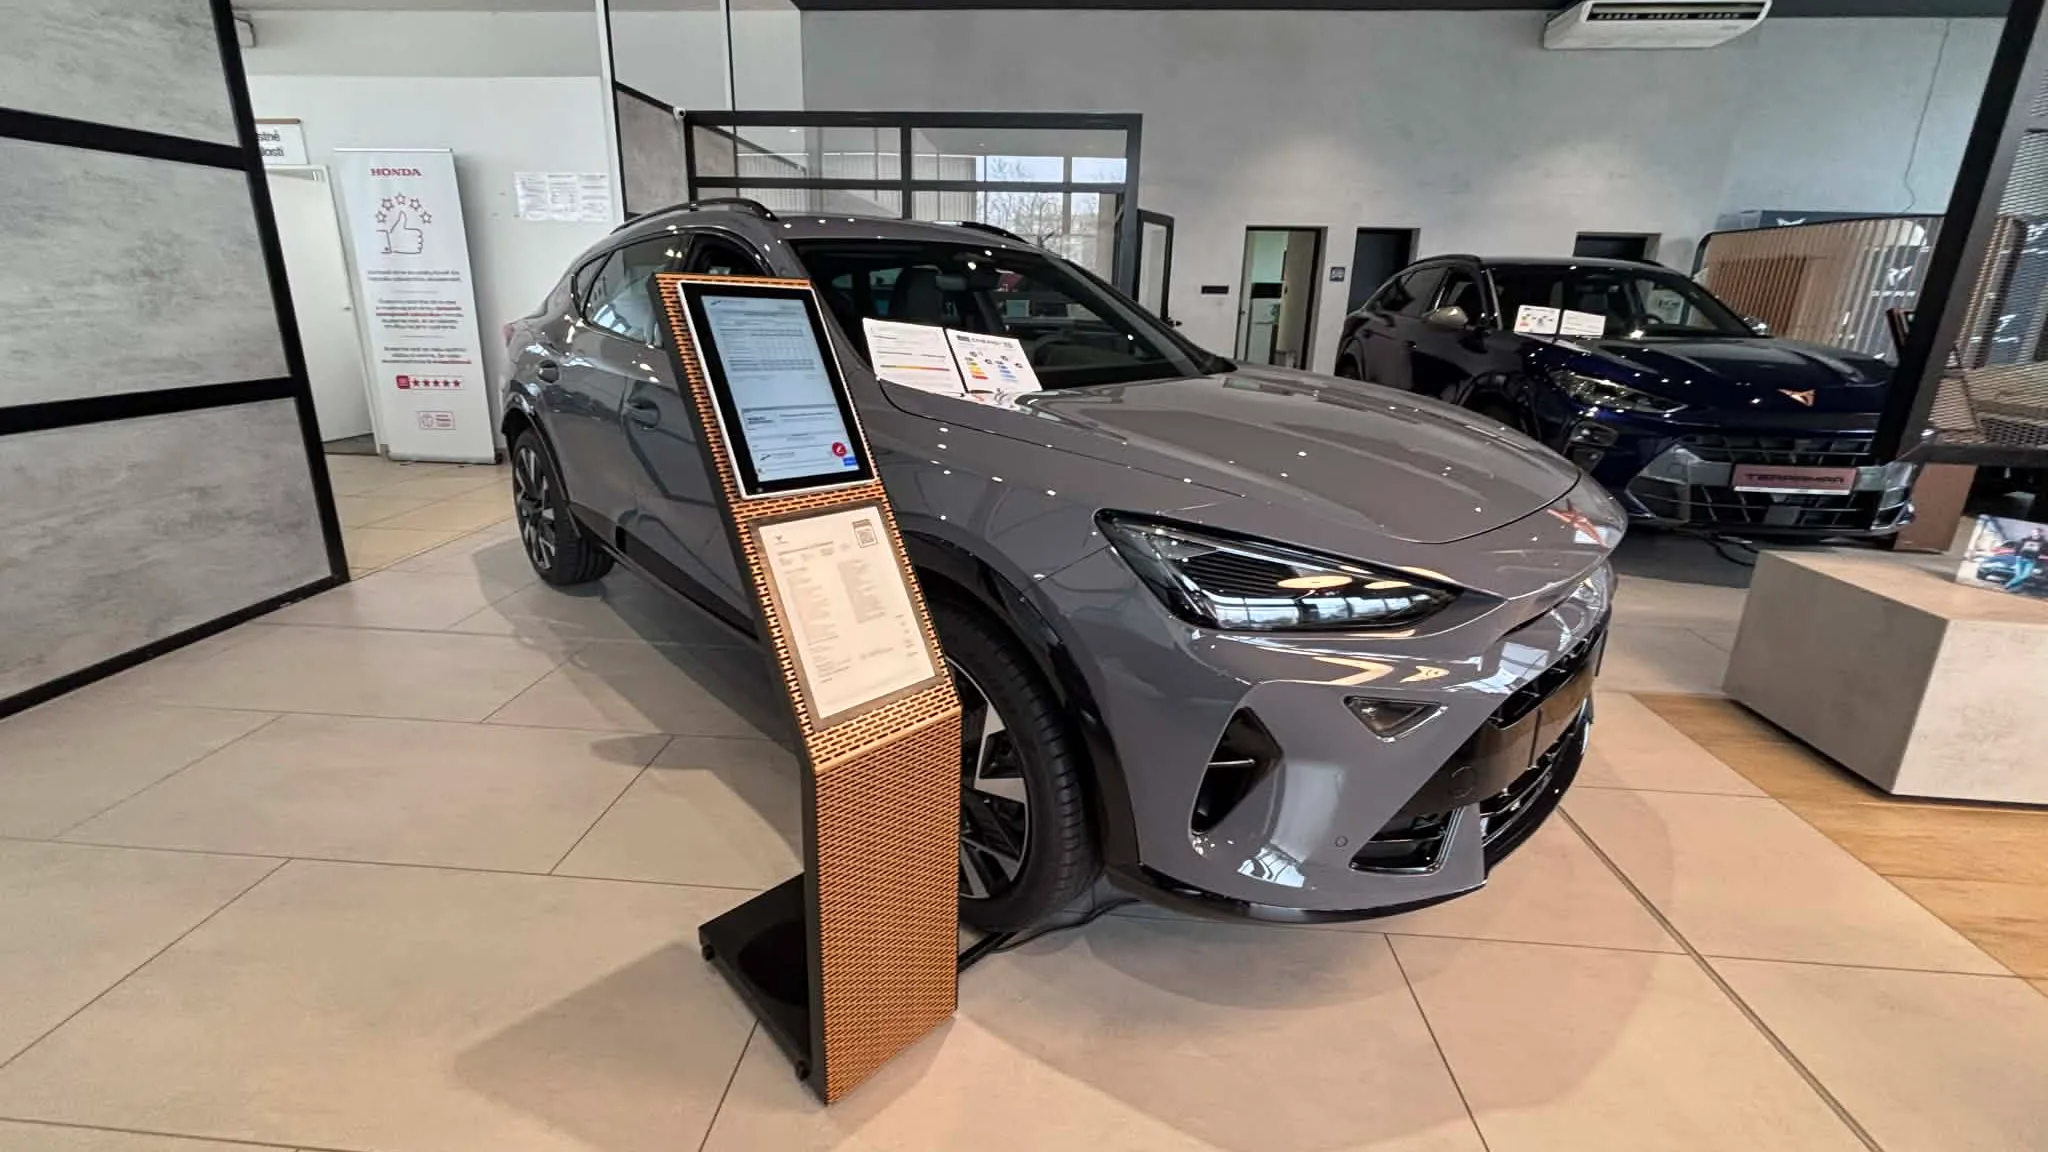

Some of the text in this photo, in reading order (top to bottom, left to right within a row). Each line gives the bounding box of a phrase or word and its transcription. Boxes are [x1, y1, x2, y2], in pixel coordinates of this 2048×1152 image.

[257, 130, 280, 141] stné
[260, 146, 284, 157] losti
[370, 168, 422, 176] HONDA
